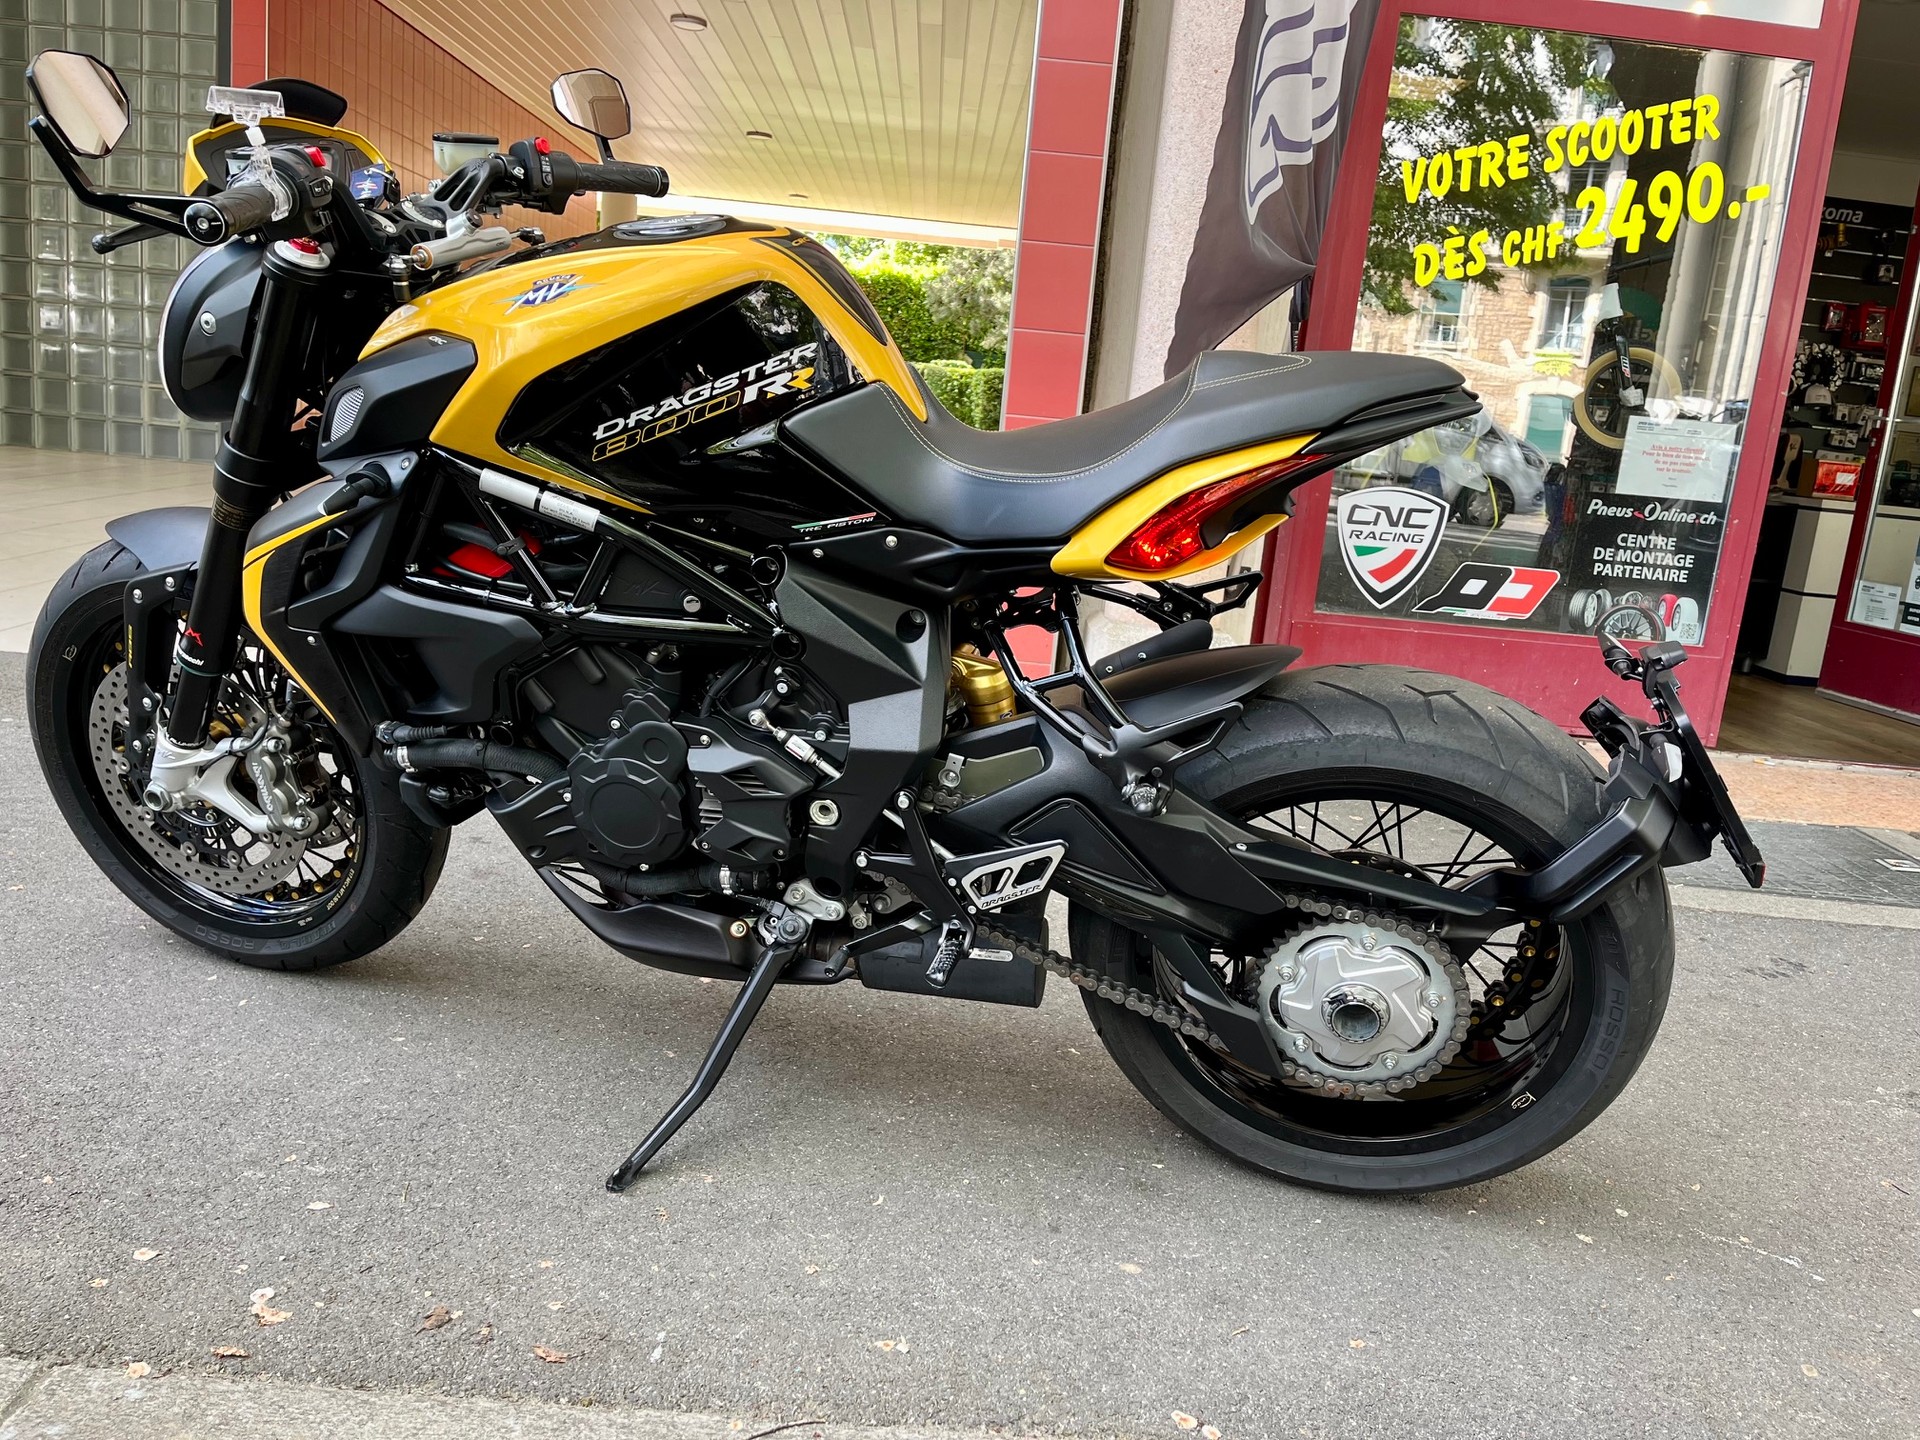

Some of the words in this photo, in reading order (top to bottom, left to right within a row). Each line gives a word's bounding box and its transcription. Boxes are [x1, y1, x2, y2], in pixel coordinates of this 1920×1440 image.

[1401, 134, 1530, 204] VOTRE
[1543, 93, 1721, 173] SCOOTER
[1413, 226, 1489, 288] DÈS
[1503, 221, 1564, 268] CHF
[1575, 161, 1771, 254] 2490.-
[1822, 206, 1864, 223] oma
[503, 275, 584, 316] MV
[592, 342, 819, 440] DRAGSTER
[827, 517, 874, 529] PISTONI
[1346, 503, 1434, 529] CNC
[1349, 530, 1424, 544] RACING
[1616, 533, 1677, 550] CENTRE
[1593, 547, 1614, 561] DE
[1616, 549, 1695, 568] MONTAGE
[1593, 562, 1689, 583] PARTENAIRE
[252, 763, 273, 811] brembo
[981, 885, 1041, 908] DRAGSTER
[195, 924, 254, 950] ROSSO
[1591, 988, 1626, 1071] ROSSO
